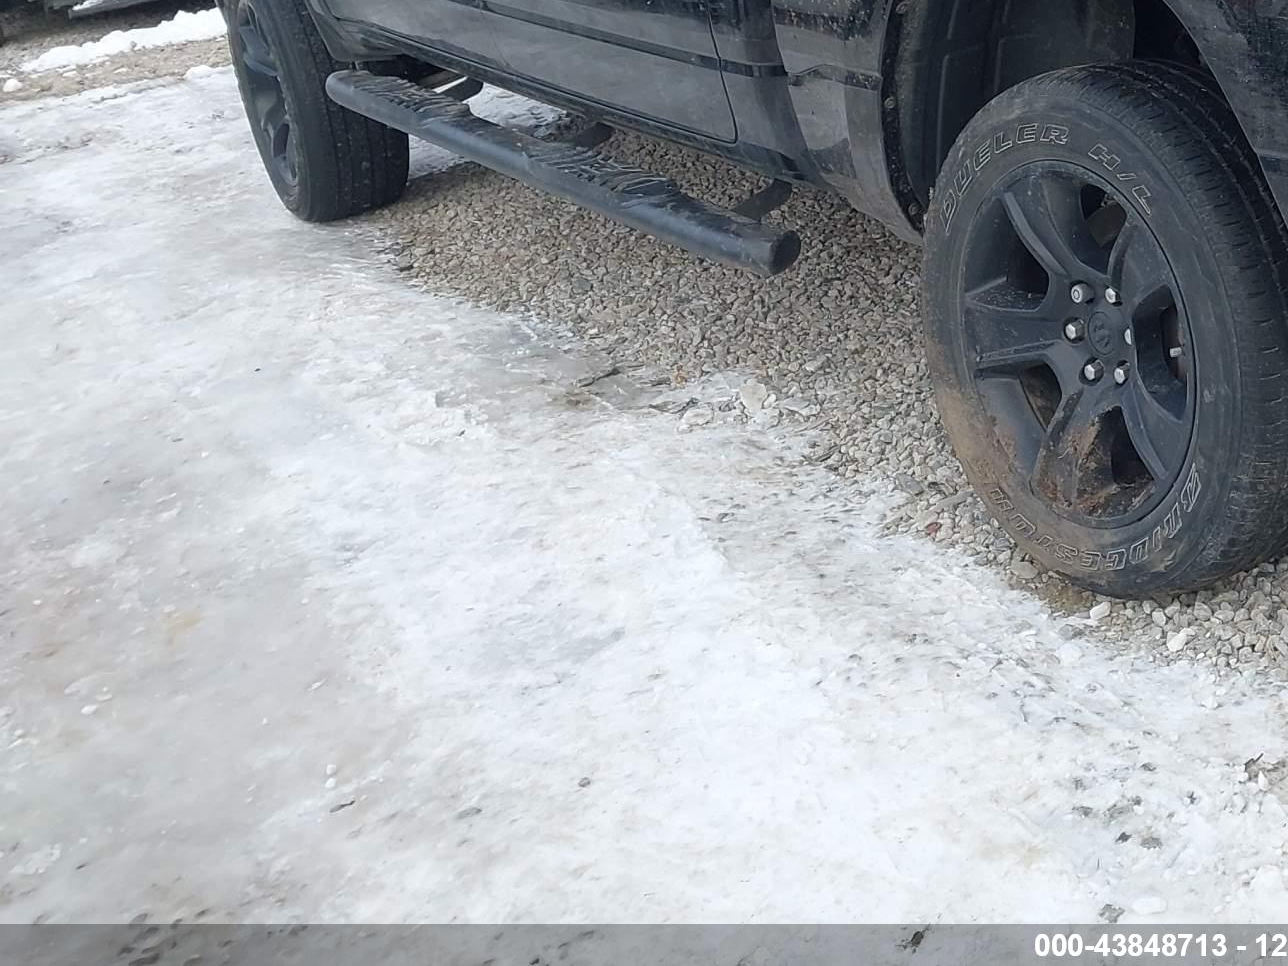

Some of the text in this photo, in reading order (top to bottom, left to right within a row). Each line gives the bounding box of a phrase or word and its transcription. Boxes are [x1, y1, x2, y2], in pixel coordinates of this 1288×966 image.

[939, 122, 1153, 236] DUELER H/L
[988, 461, 1203, 572] BRIDGESTON
